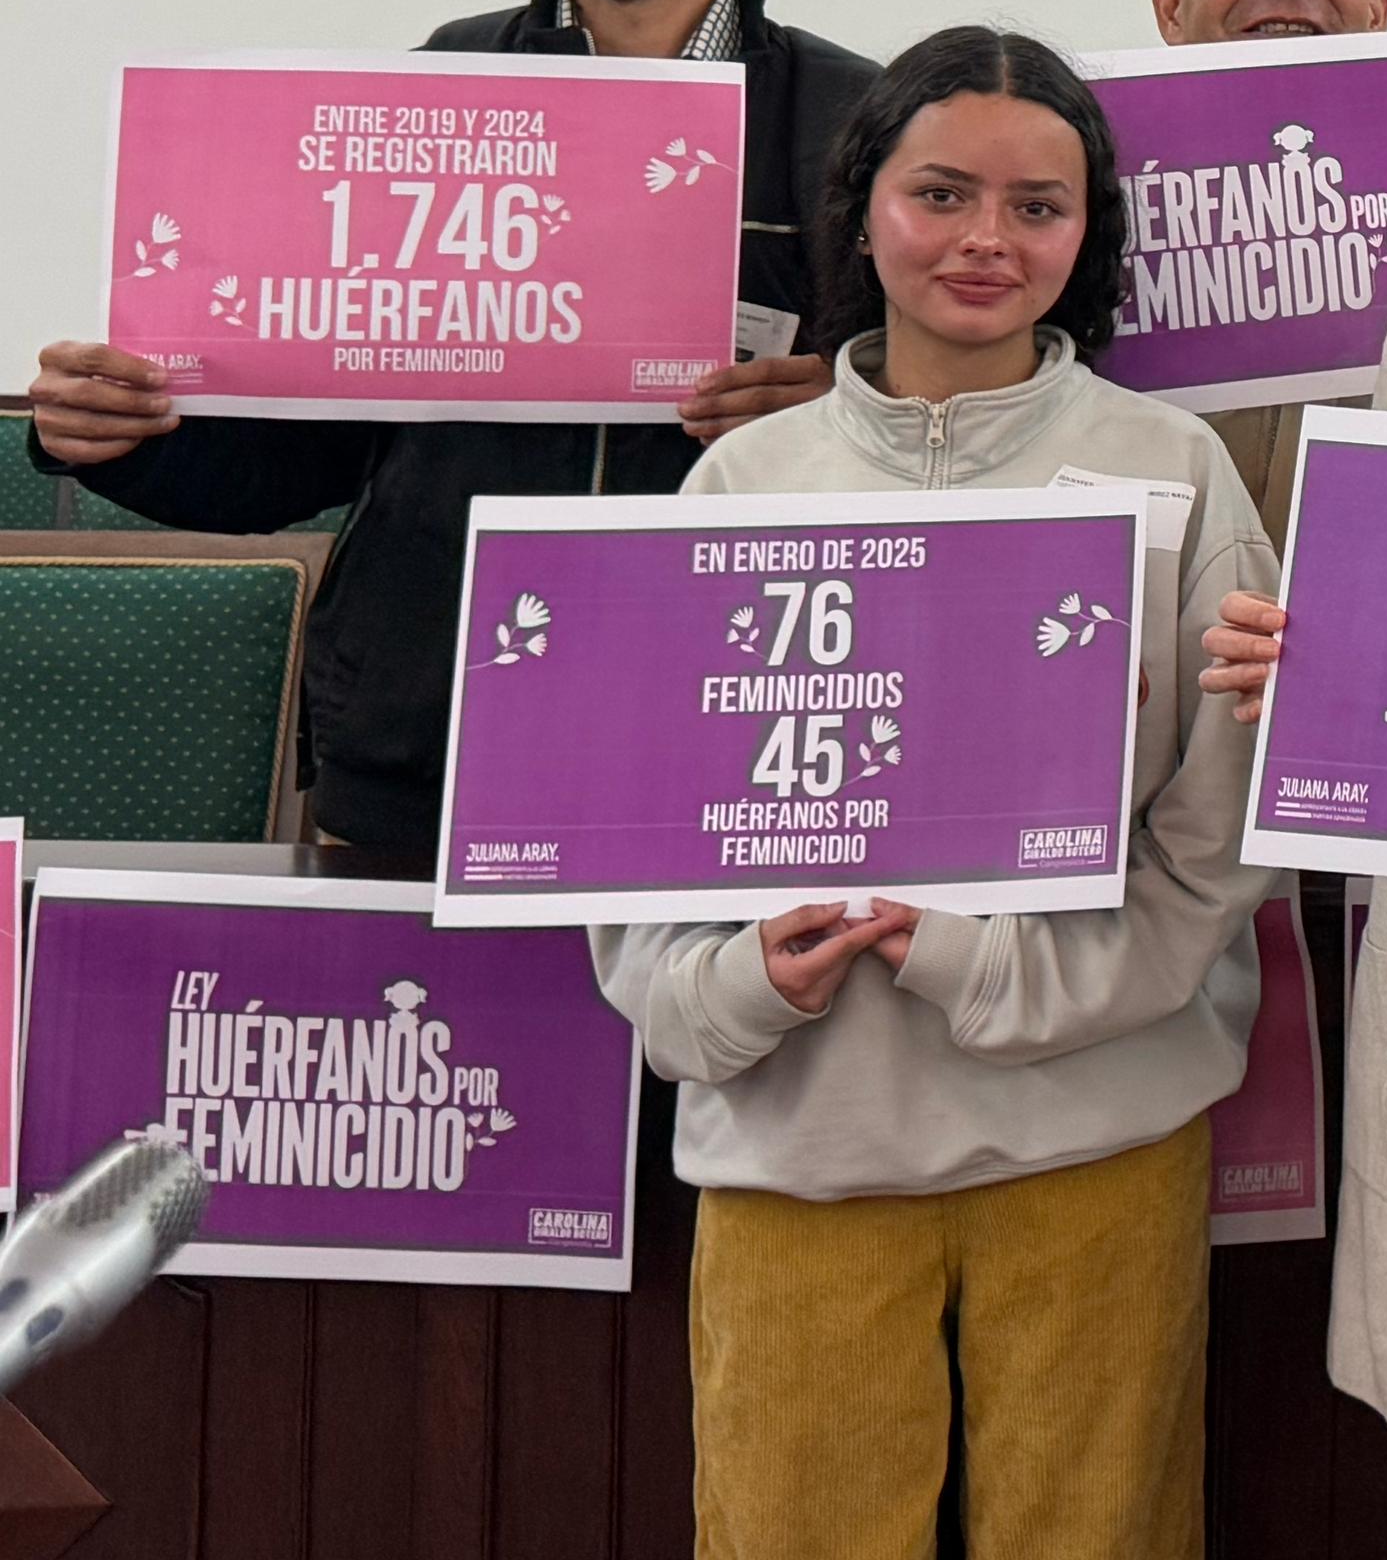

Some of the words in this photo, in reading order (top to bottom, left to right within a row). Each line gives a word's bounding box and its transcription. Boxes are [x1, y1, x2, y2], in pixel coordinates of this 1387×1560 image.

[314, 105, 390, 134] ENTRE
[395, 108, 456, 136] 2019
[461, 109, 480, 136] Y
[485, 110, 546, 138] 2024
[297, 136, 336, 171] SE
[345, 136, 558, 177] REGISTRARON
[322, 180, 540, 272] 1.746
[1119, 157, 1347, 255] ÉRFANOS
[258, 265, 584, 344] HUÉRFANOS
[333, 347, 373, 373] POR
[379, 348, 505, 374] FEMINICIDIO
[693, 543, 728, 574] EN
[734, 541, 815, 572] ENERO
[821, 540, 854, 571] DE
[860, 536, 927, 569] 2025
[762, 579, 852, 667] 76
[702, 672, 904, 714] FEMINICIDIOS
[751, 714, 844, 798] 45
[1278, 777, 1329, 800] JULIANA
[1331, 782, 1369, 803] ARAY.
[702, 797, 838, 832] HUÉRFANOS
[844, 799, 889, 829] POR
[466, 843, 519, 861] JULIANA
[521, 843, 559, 861] ARAY.
[720, 834, 867, 867] FEMINICIDIO
[1024, 829, 1102, 849] CAROLINA
[170, 970, 220, 1011] LEY
[165, 999, 452, 1107] HUÉRFANOS
[453, 1067, 499, 1107] POR
[163, 1097, 468, 1192] FEMINICIDIO
[533, 1211, 607, 1231] CAROLINA
